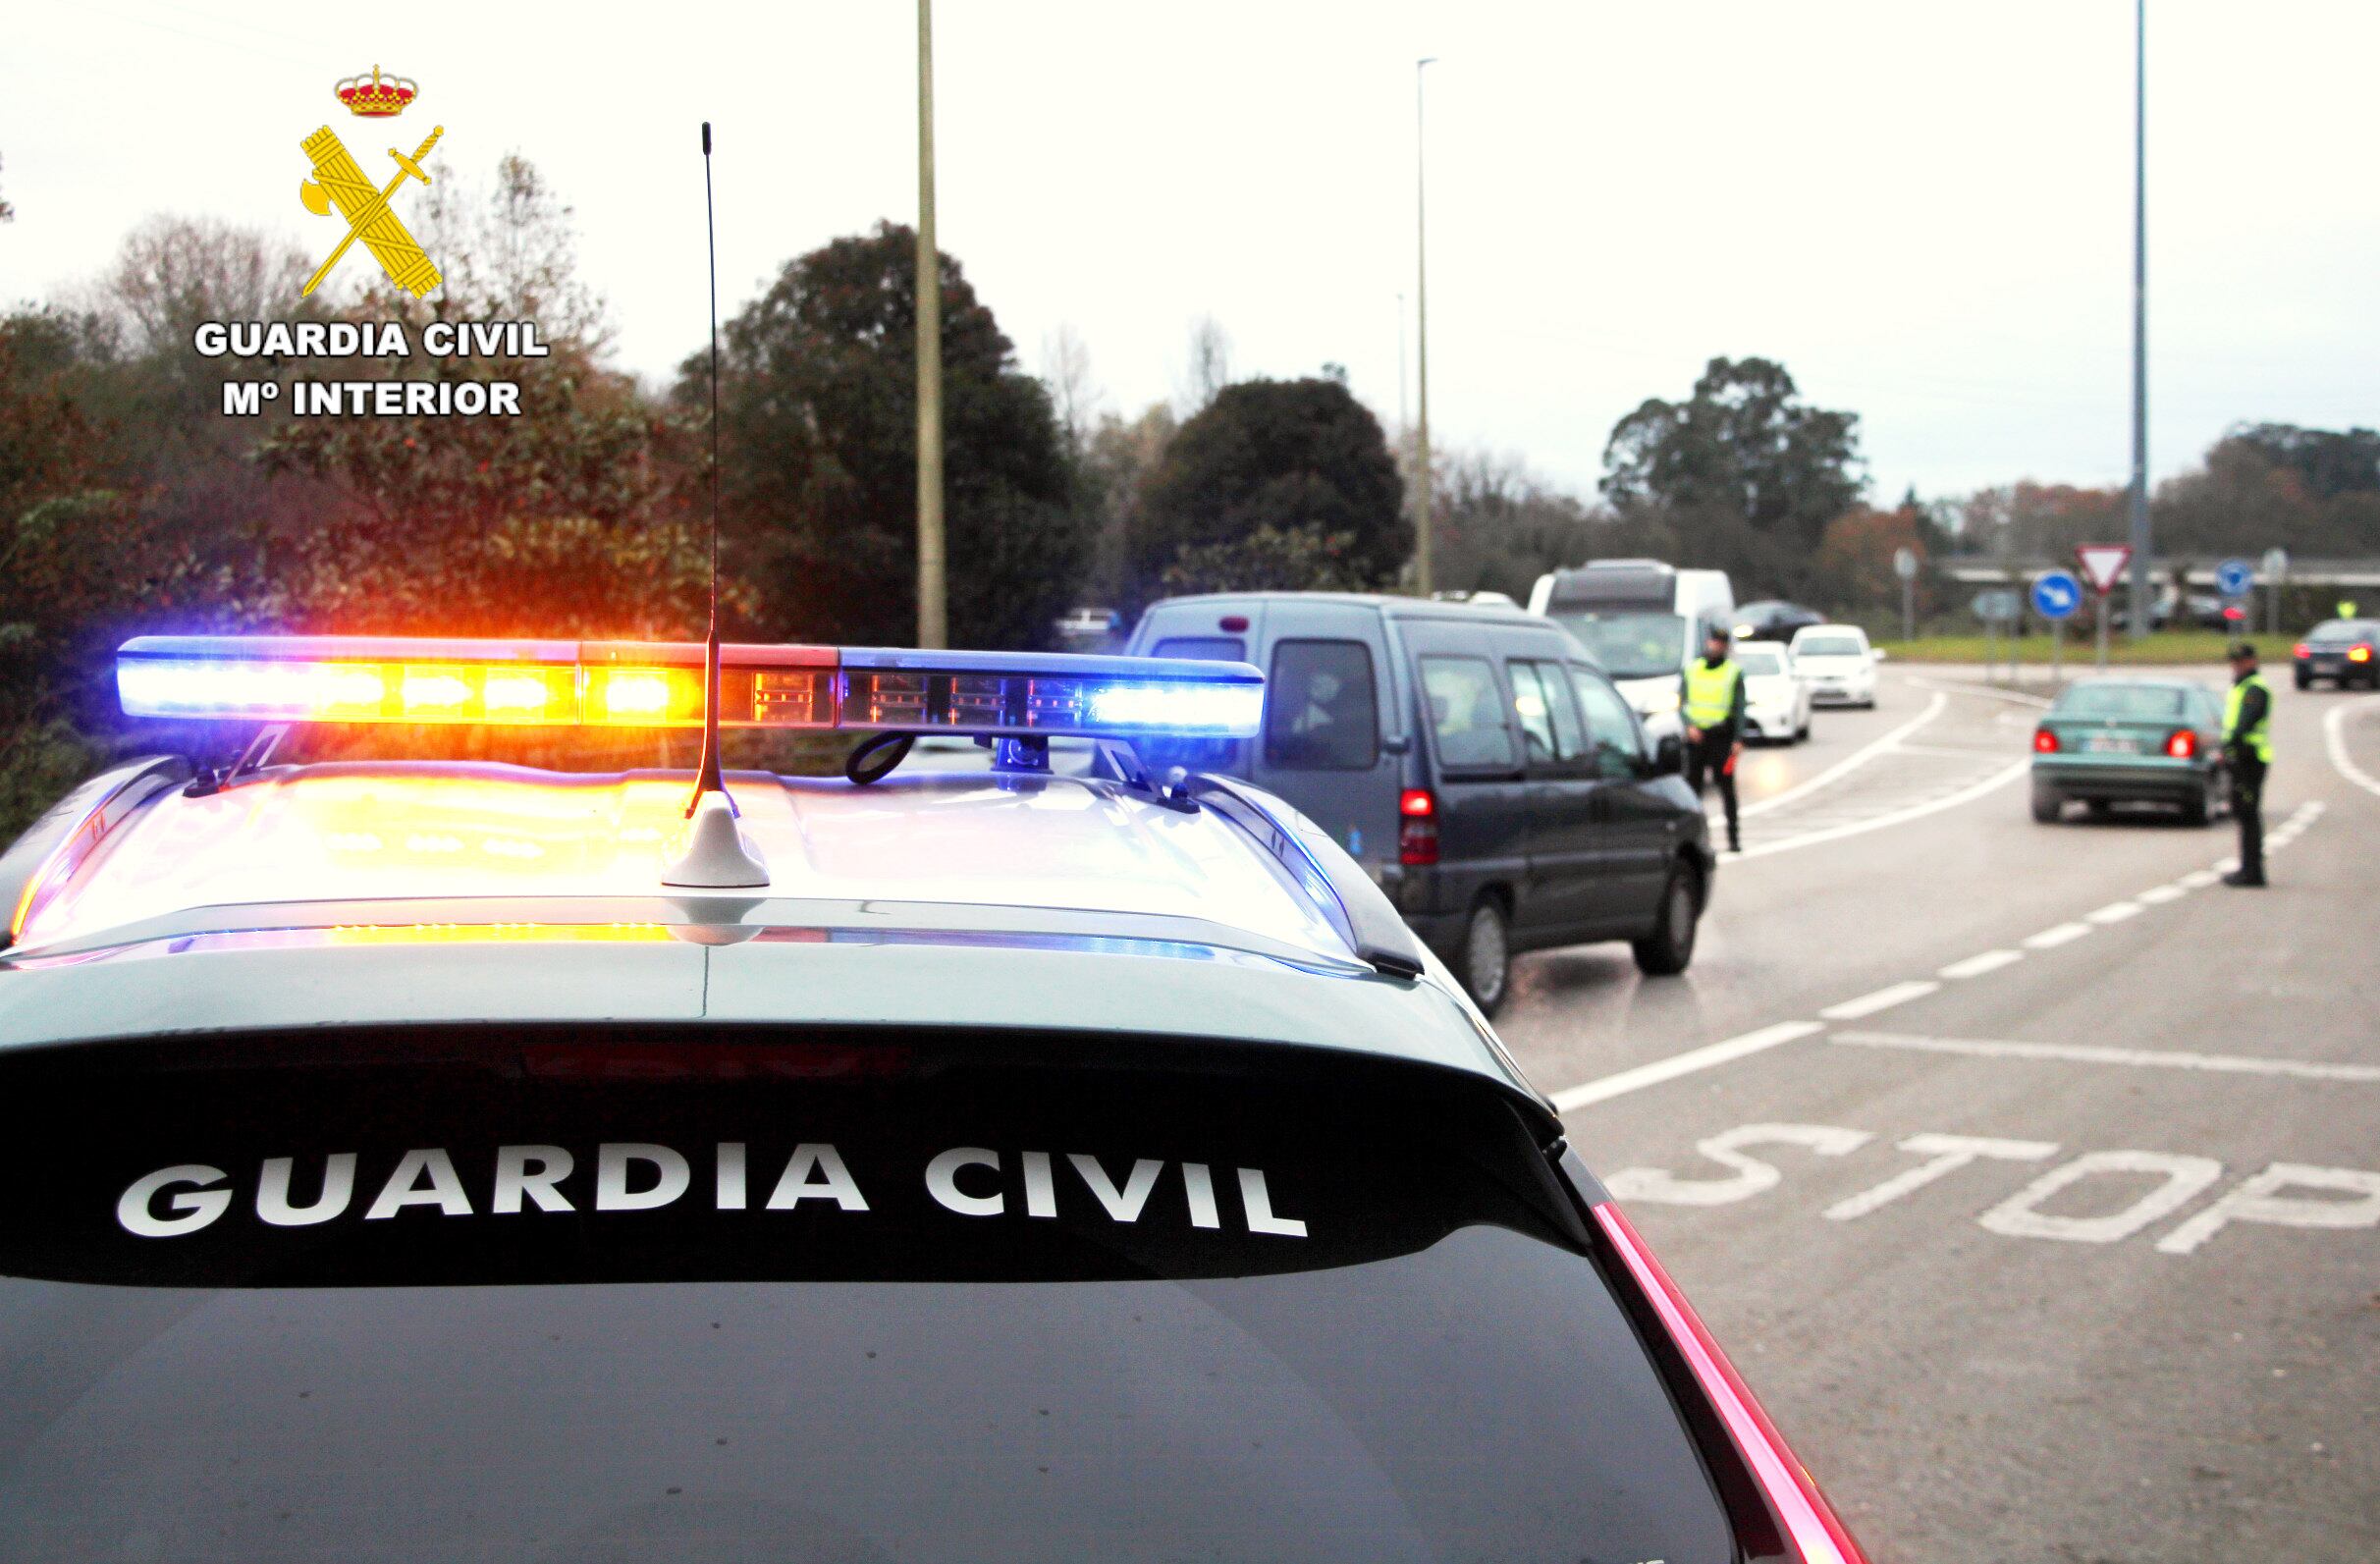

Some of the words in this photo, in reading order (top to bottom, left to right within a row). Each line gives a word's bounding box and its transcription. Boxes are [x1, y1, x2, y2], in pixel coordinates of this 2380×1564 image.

[116, 1142, 871, 1238] GUARDIA
[924, 1146, 1309, 1238] CIVIL
[1608, 1122, 2380, 1255] STOP
